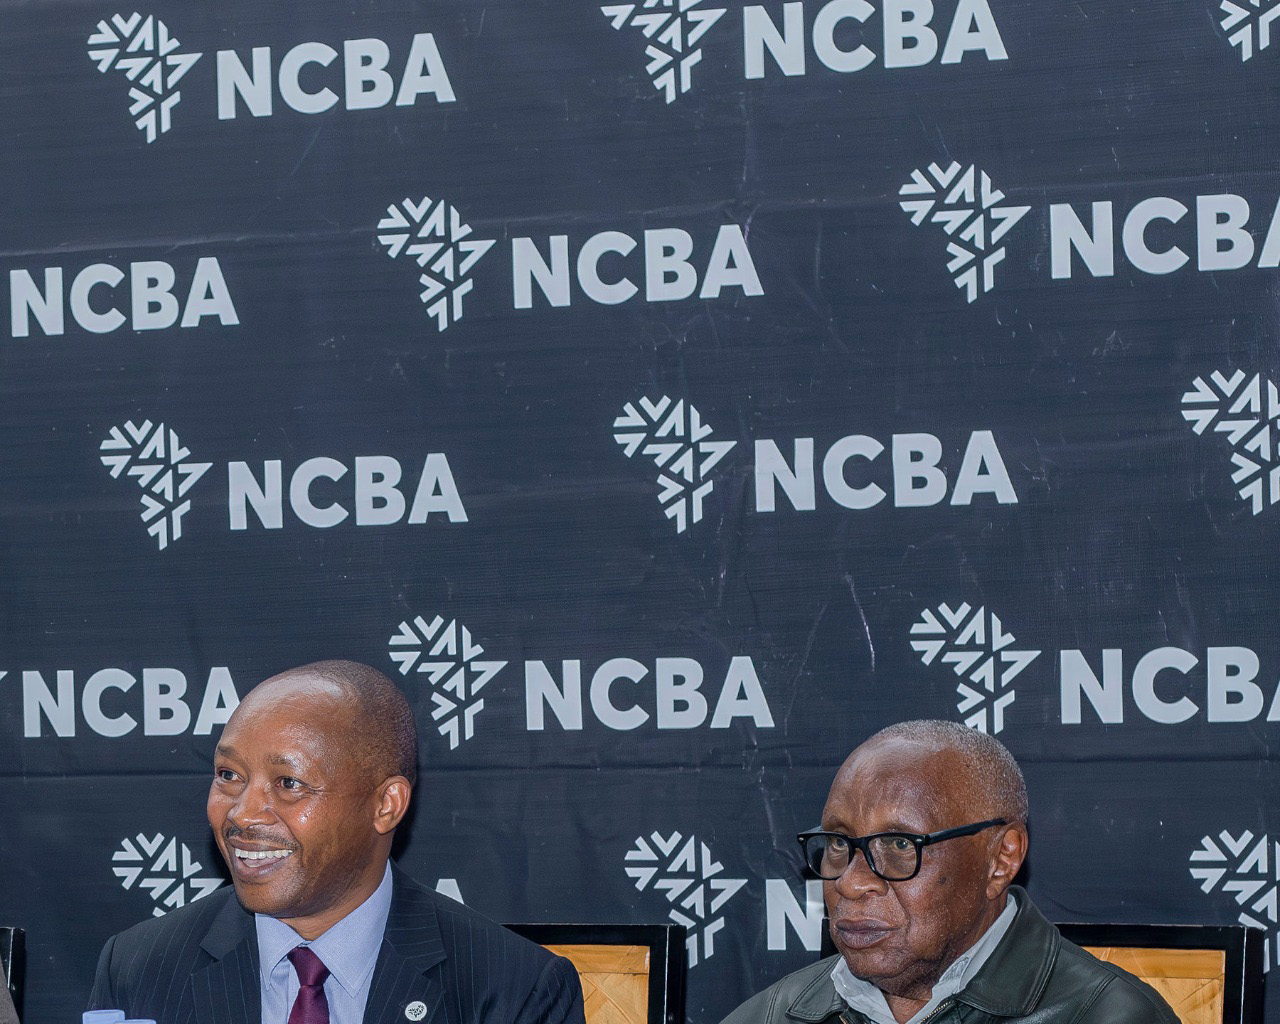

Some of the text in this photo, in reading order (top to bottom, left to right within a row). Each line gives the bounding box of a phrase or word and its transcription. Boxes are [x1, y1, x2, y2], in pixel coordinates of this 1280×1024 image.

[216, 32, 457, 120] NCBA
[743, 0, 1009, 79] NCBA
[9, 256, 240, 338] NCBA
[511, 223, 765, 310] NCBA
[227, 452, 469, 531] NCBA
[754, 429, 1019, 513] NCBA
[22, 666, 240, 738] NCBA
[524, 655, 776, 731] NCBA
[1060, 646, 1280, 725] NCB
